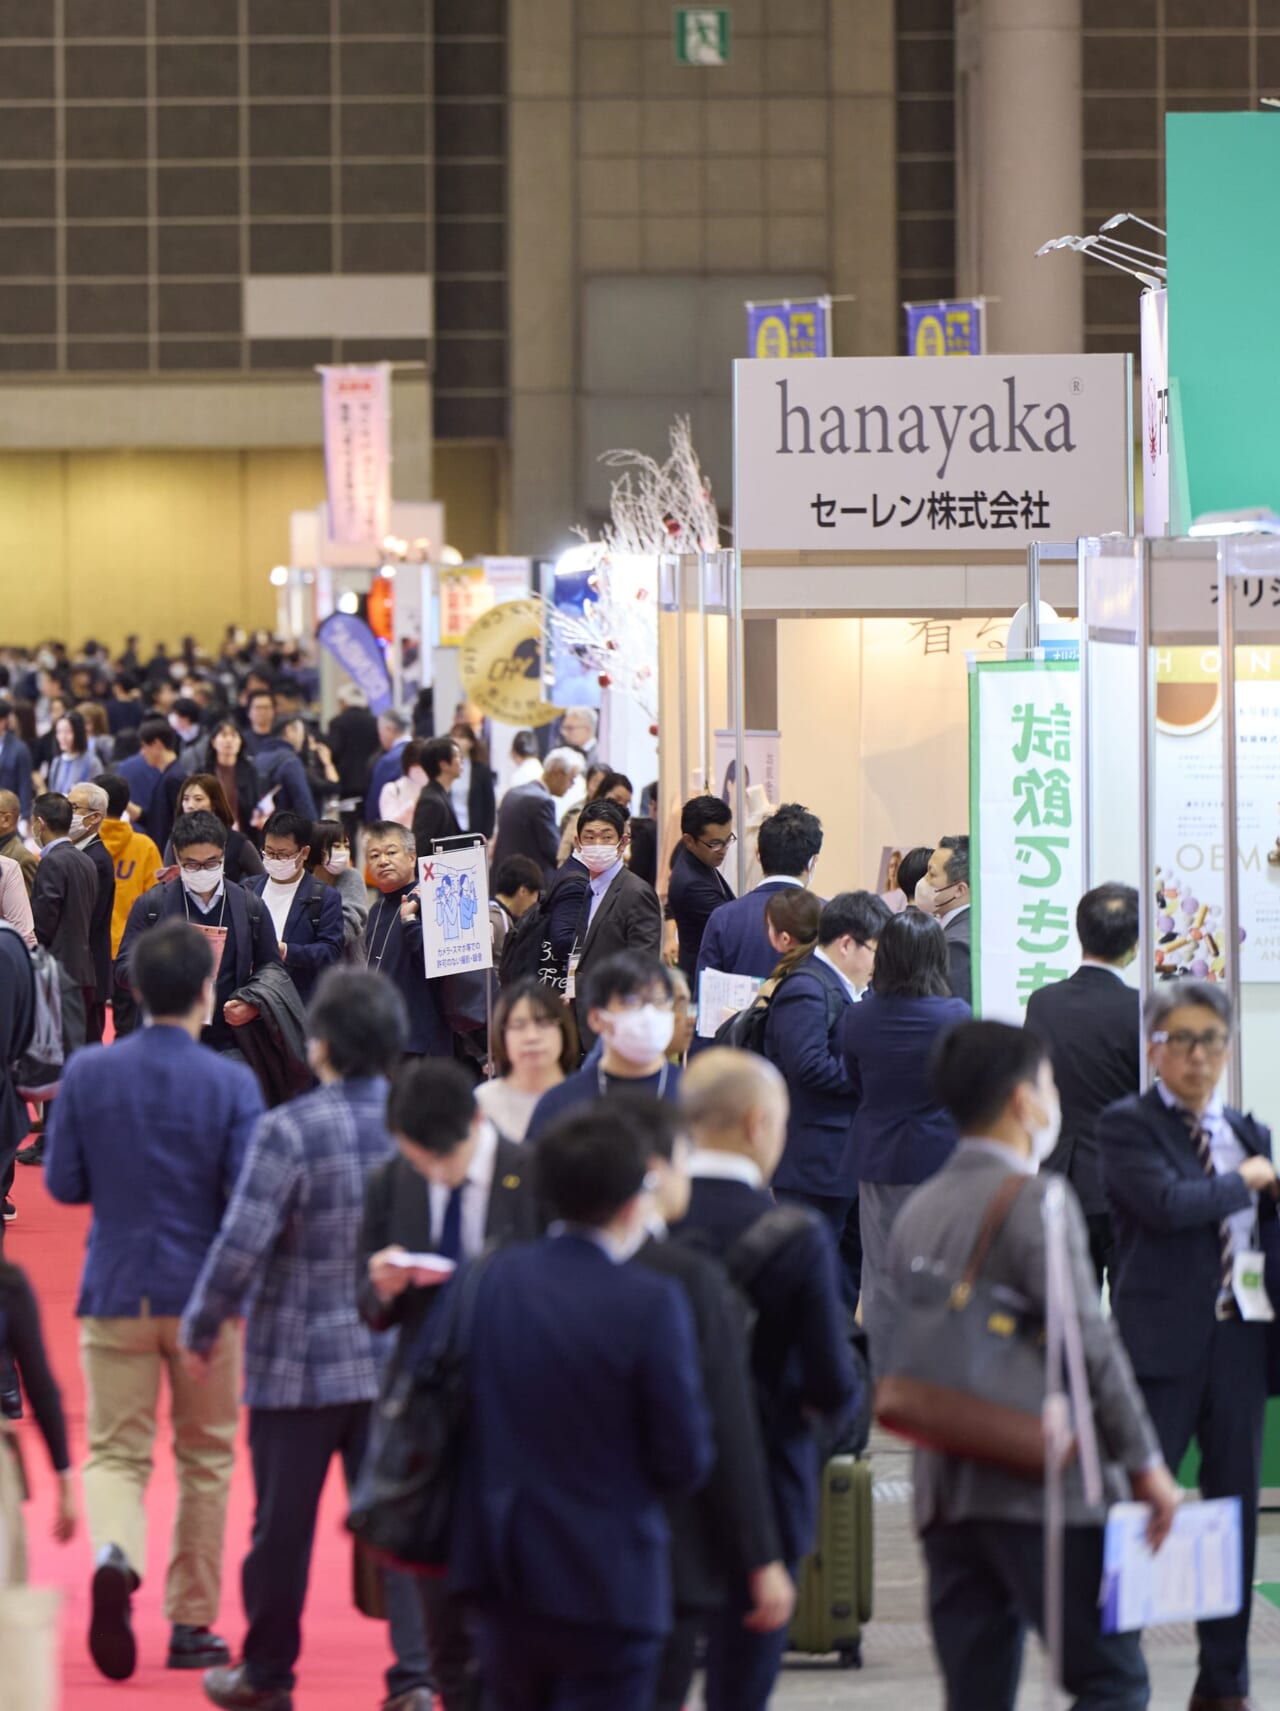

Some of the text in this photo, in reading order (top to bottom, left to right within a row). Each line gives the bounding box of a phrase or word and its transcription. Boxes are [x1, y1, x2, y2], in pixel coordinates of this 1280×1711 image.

[775, 376, 1077, 480] hanayaka
[810, 490, 1050, 530] セーレン株式会社
[116, 859, 136, 880] U
[1176, 843, 1262, 872] OEM
